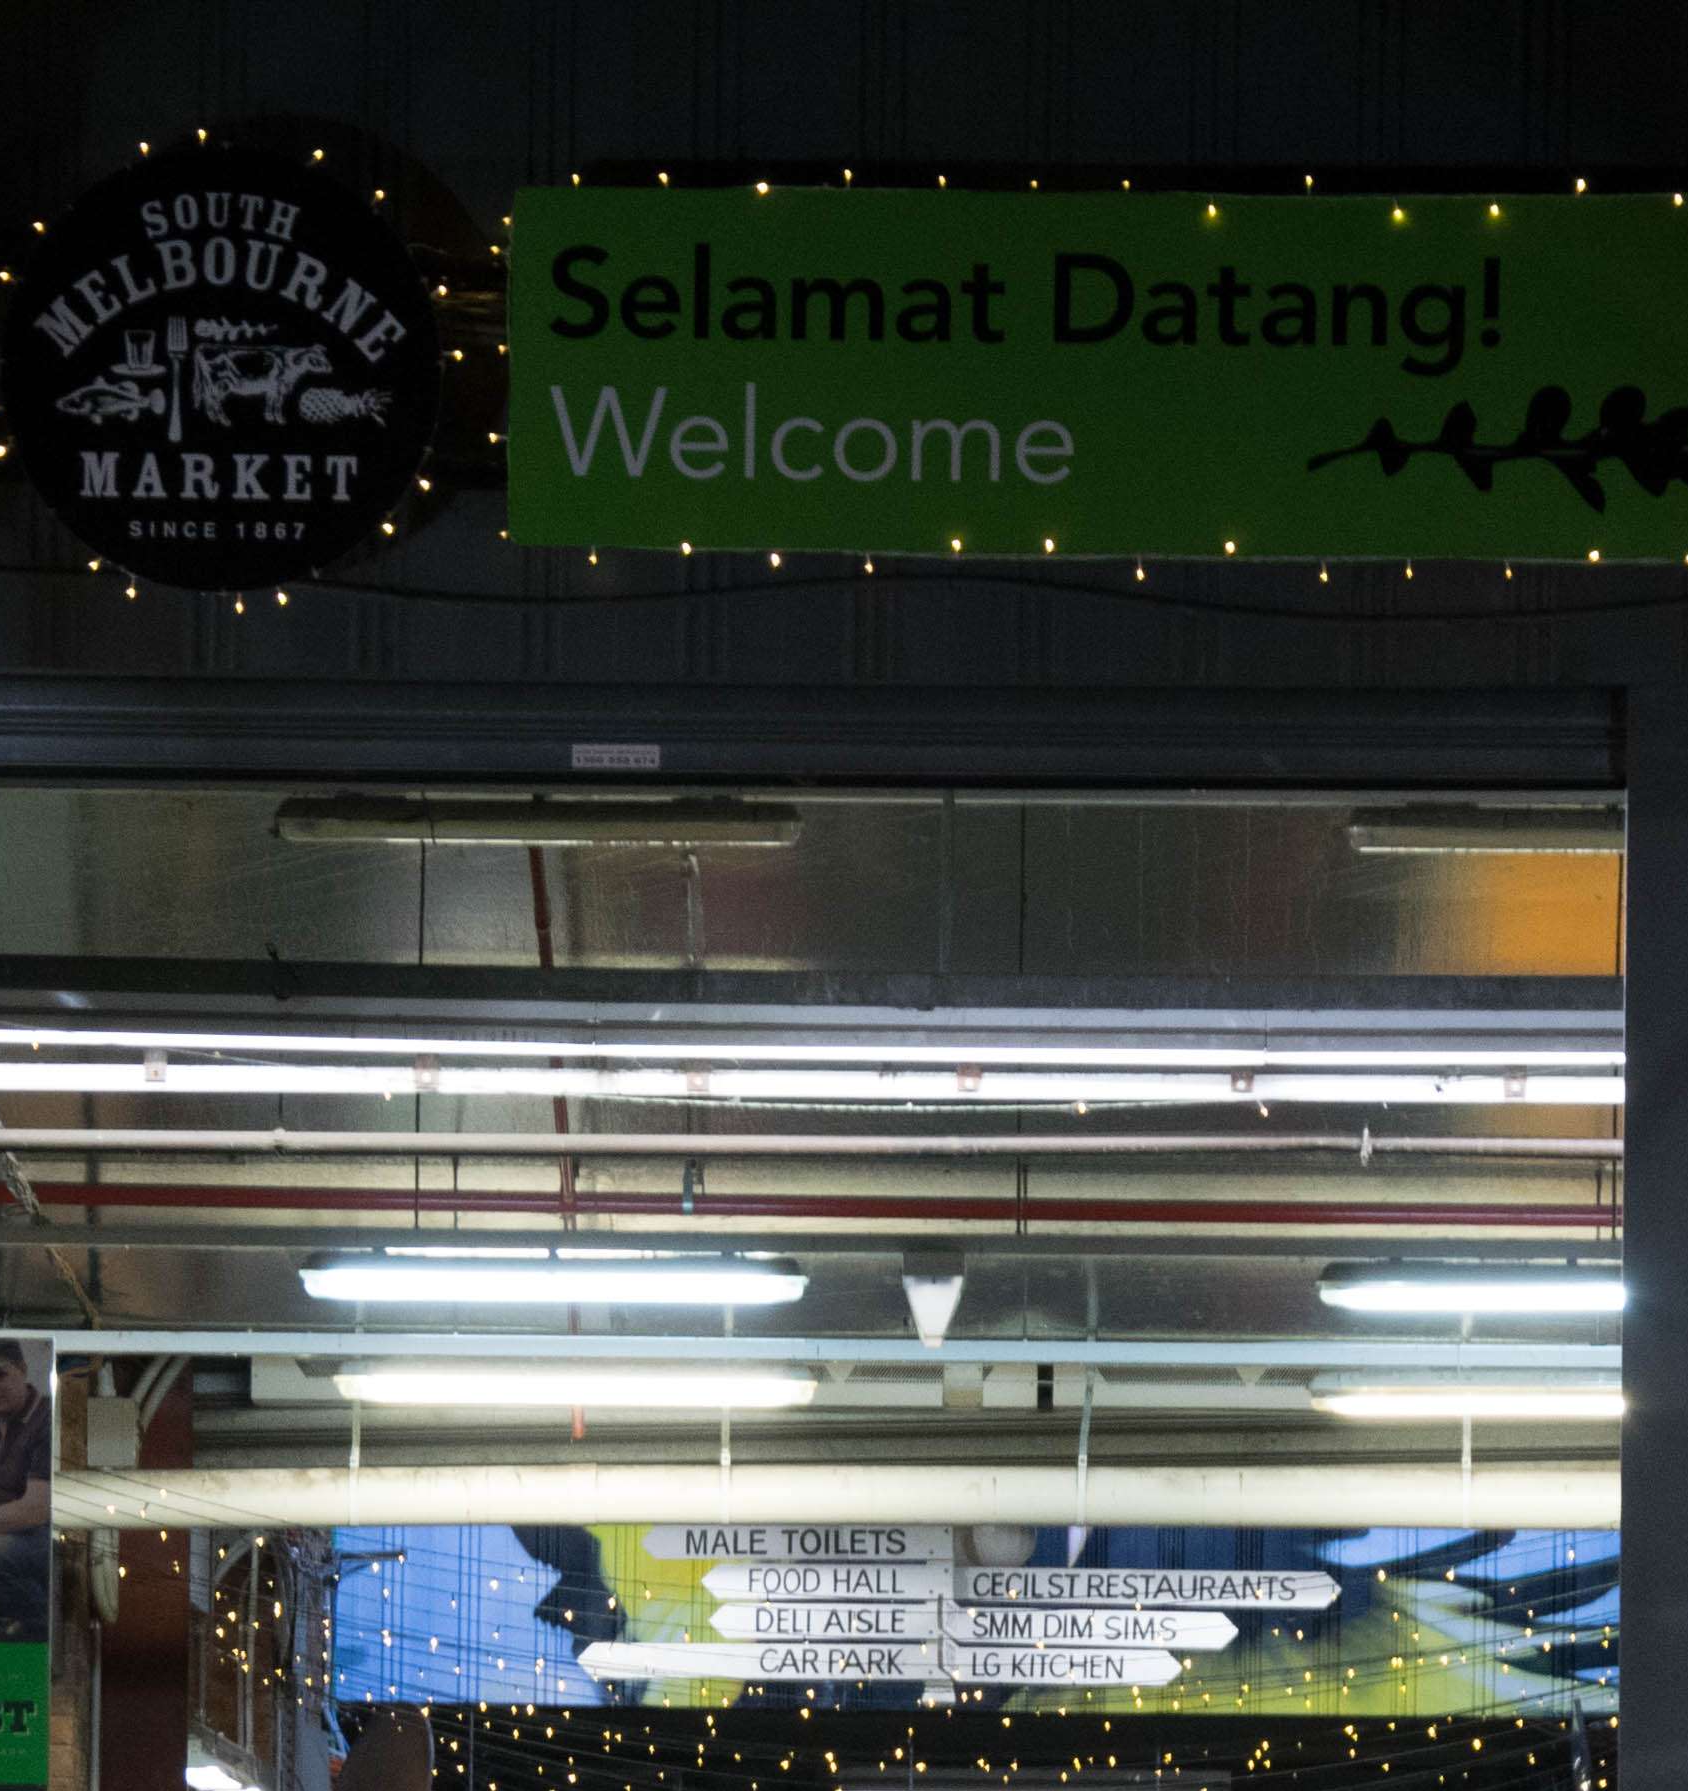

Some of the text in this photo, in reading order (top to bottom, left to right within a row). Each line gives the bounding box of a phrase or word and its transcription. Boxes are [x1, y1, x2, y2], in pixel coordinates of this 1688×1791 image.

[140, 192, 300, 241] SOUTH
[33, 236, 407, 363] MELBOURNE
[549, 242, 1503, 379] Selamat Datang!
[549, 382, 1076, 485] Welcome
[79, 451, 358, 502] MARKET
[128, 520, 306, 539] SINCE 1867
[685, 1528, 906, 1555] MALE TOILETS
[748, 1568, 905, 1594] FOOD HALL
[1087, 1574, 1296, 1602] RESTAURANTS
[755, 1608, 906, 1634] DELI AISLE
[972, 1612, 1178, 1642] SMM DIM SIMS
[760, 1648, 904, 1675] CAR PARK
[972, 1652, 1124, 1679] LG KITCHEN
